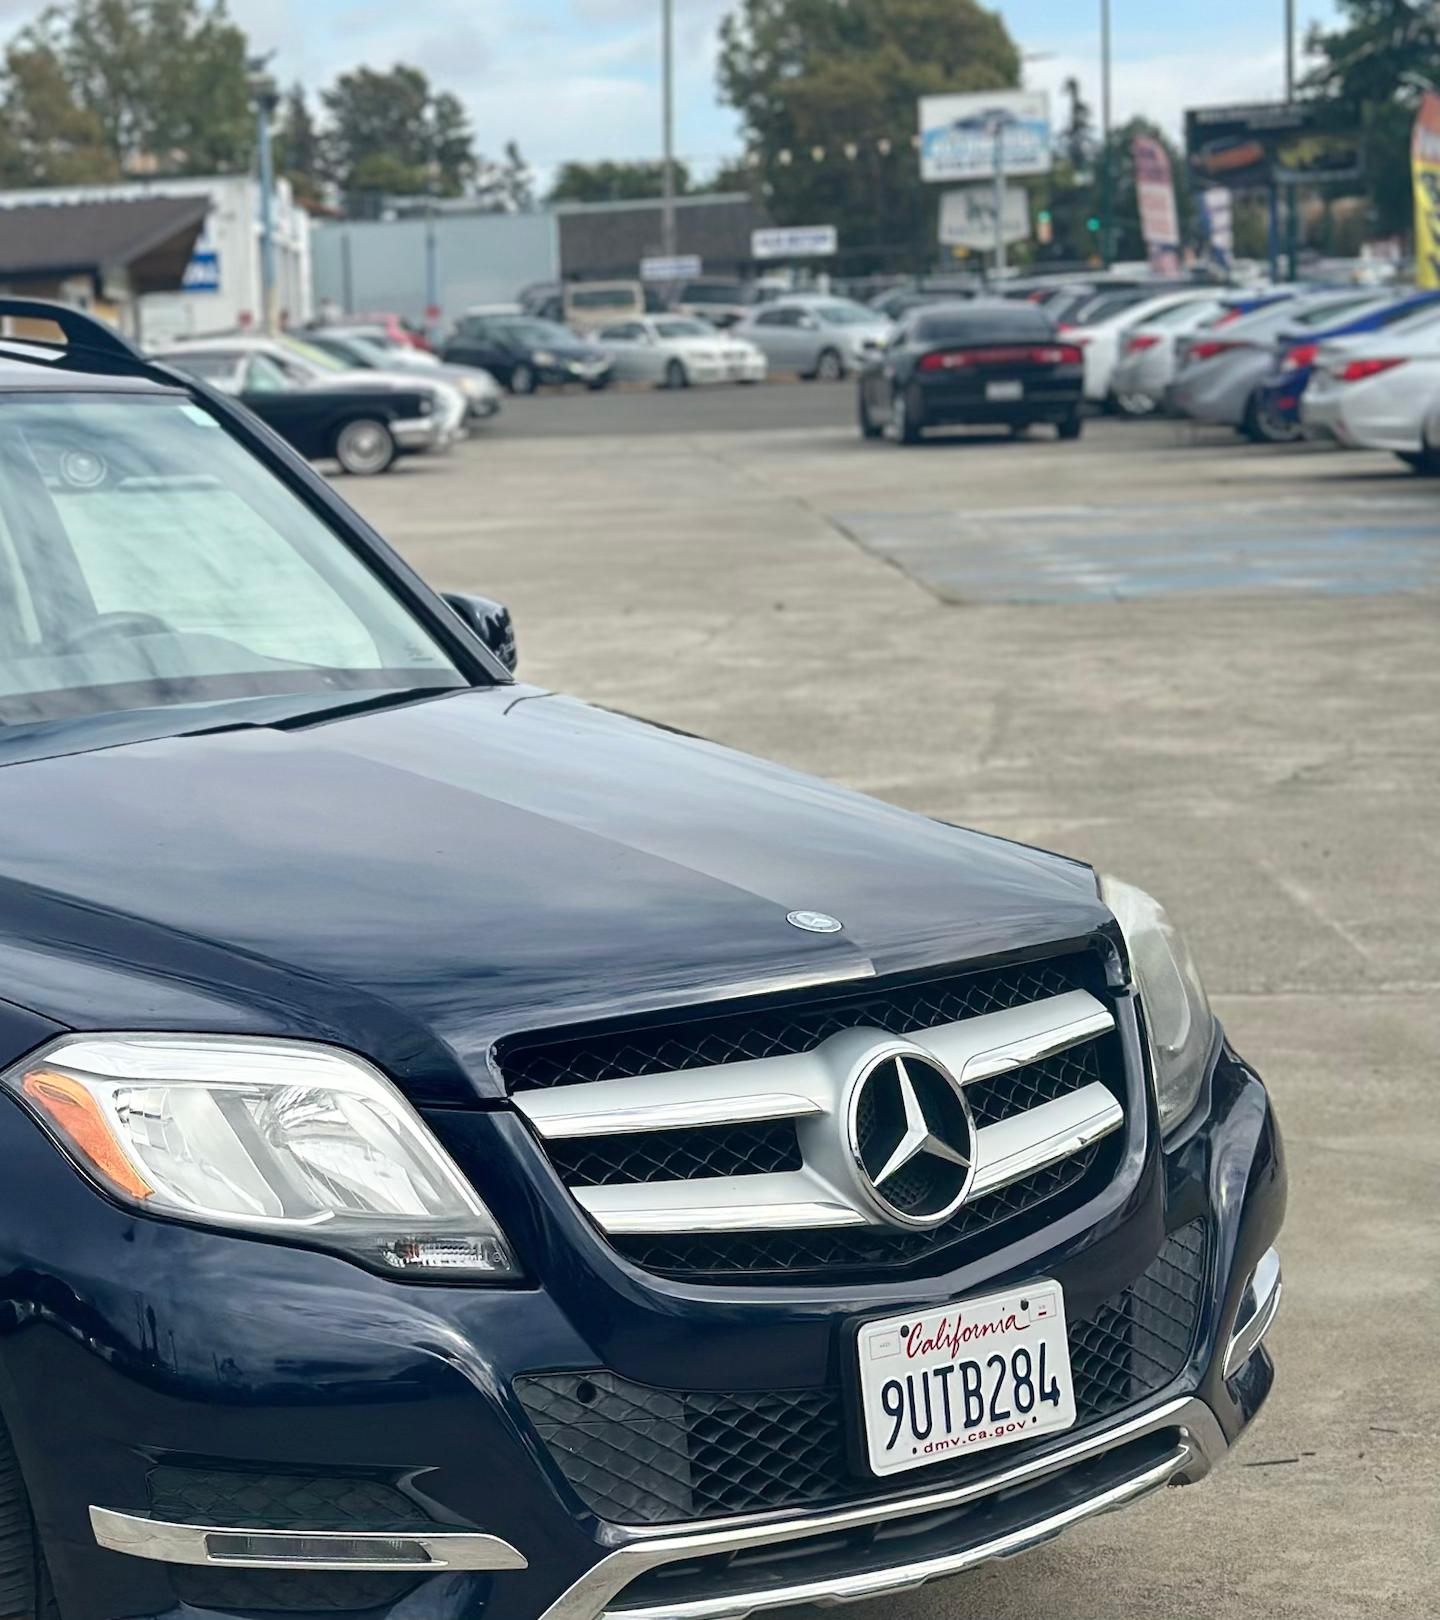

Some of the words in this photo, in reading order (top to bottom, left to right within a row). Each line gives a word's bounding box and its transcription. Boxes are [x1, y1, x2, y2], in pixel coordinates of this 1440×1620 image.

[906, 1308, 1030, 1358] California
[881, 1342, 1060, 1450] 9UTB284
[923, 1420, 1026, 1454] dmv.ca.gov
